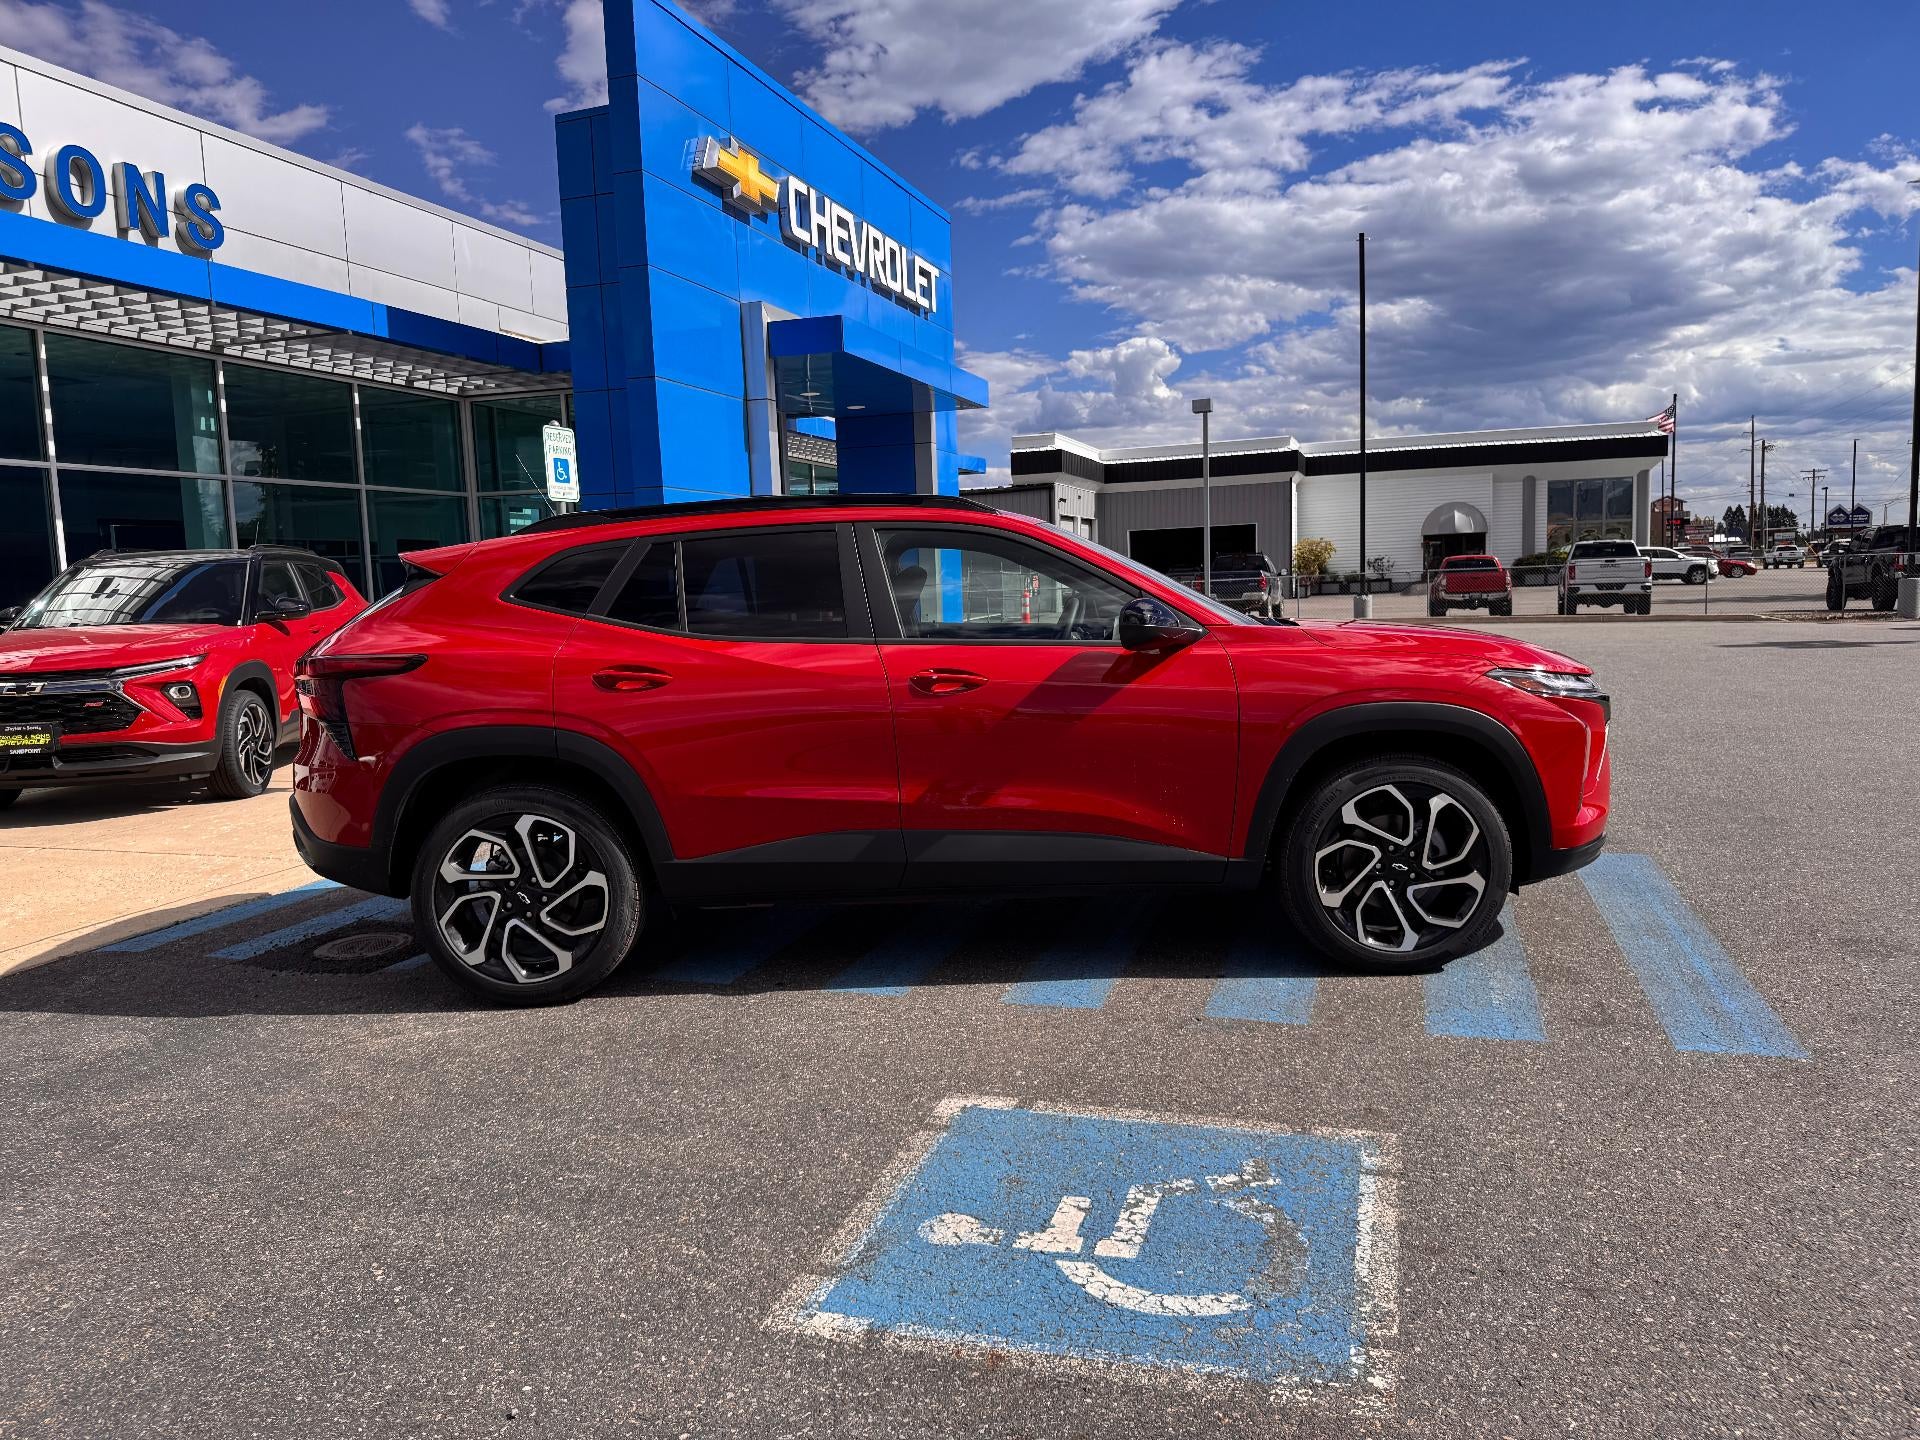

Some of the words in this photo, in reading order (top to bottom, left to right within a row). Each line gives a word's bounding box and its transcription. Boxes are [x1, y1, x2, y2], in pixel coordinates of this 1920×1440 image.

[0, 121, 225, 251] SONS
[786, 175, 940, 314] CHEVROLET
[0, 738, 51, 746] CHEVROLET
